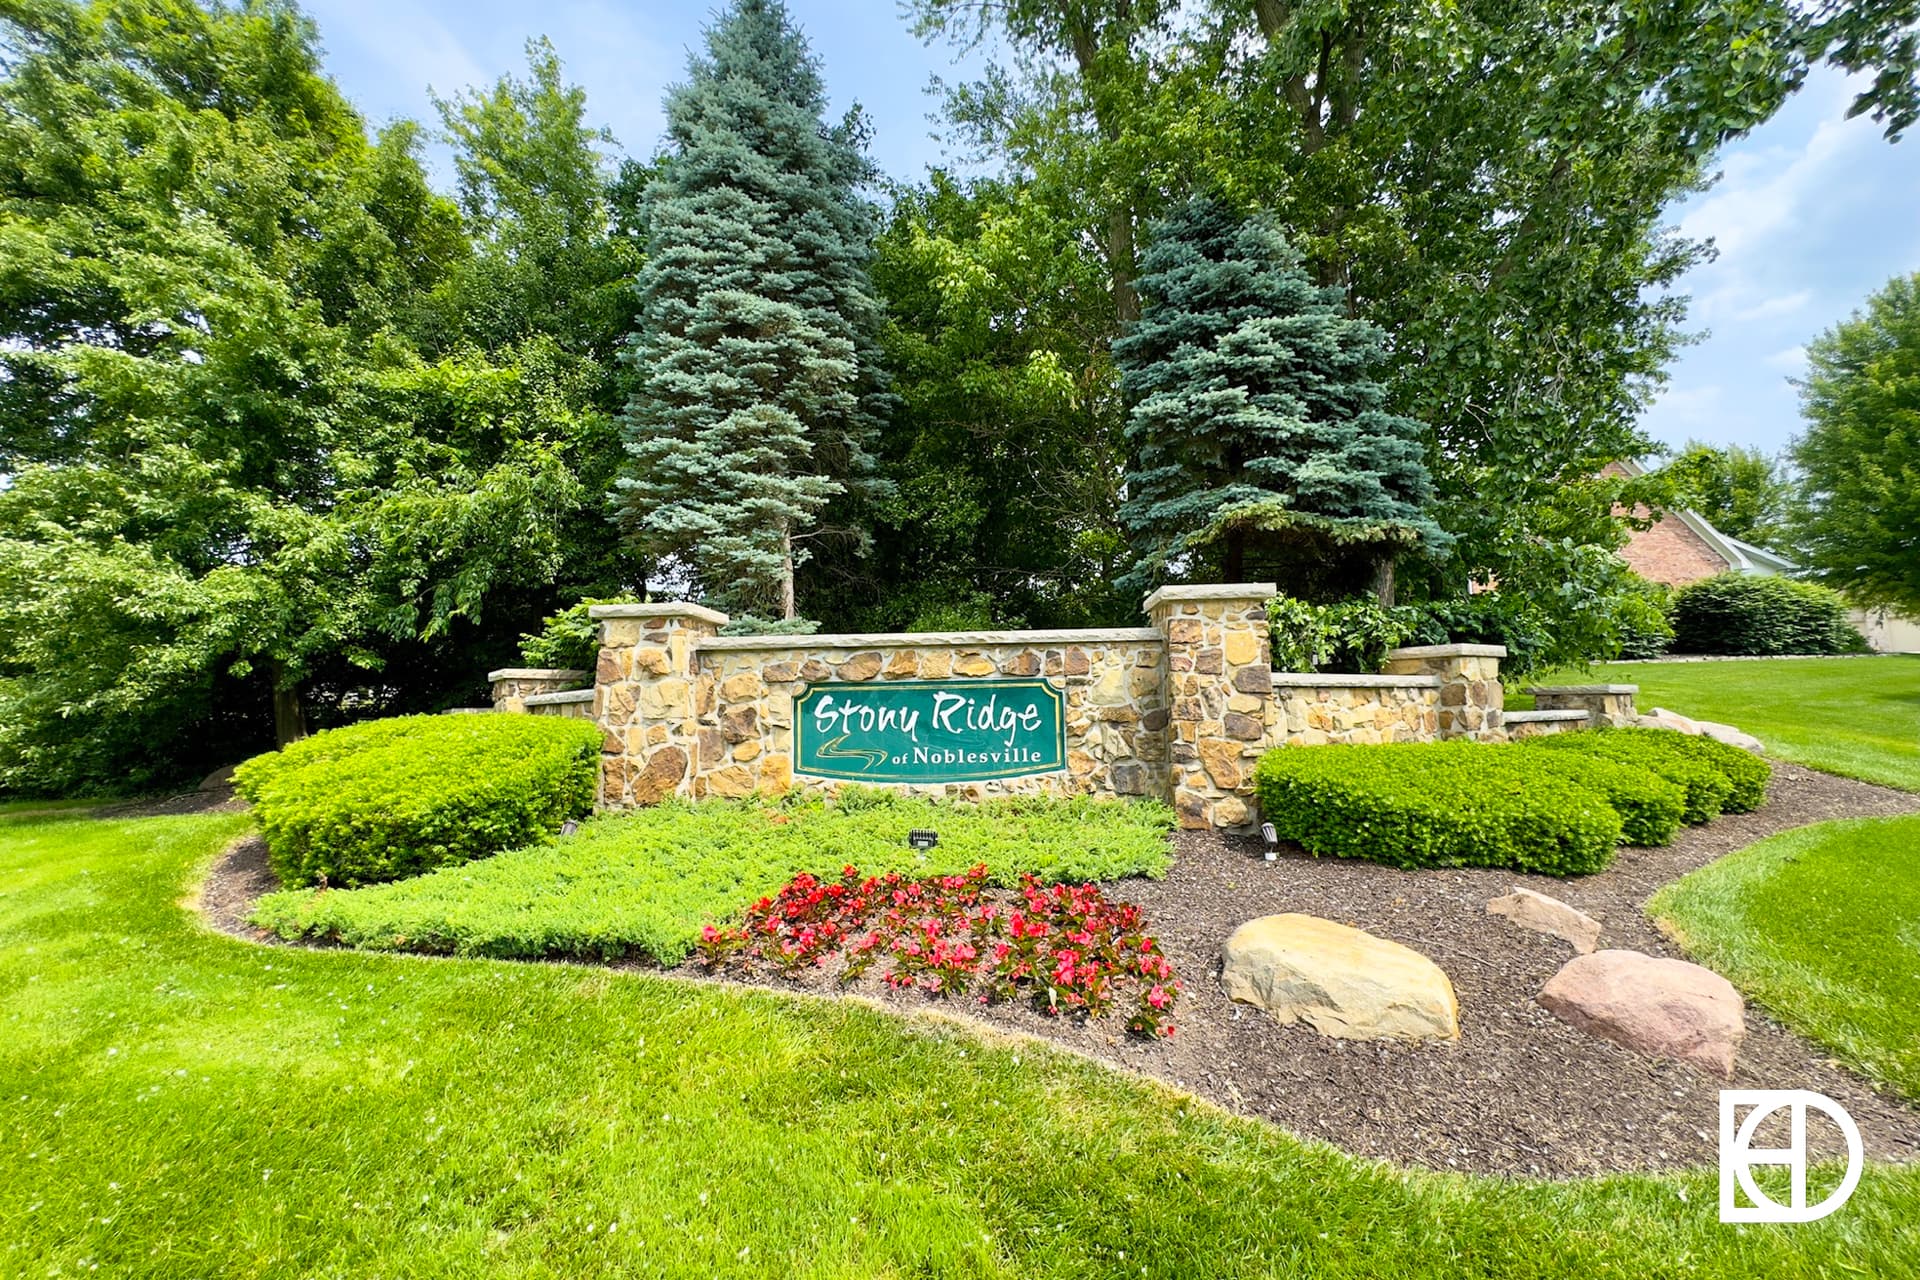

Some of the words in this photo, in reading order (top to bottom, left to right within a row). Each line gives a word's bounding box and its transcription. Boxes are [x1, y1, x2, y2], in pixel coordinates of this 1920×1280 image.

[814, 695, 920, 742] Stony
[932, 691, 1042, 747] Ridge
[892, 753, 908, 765] of
[913, 747, 1042, 765] Noblesville
